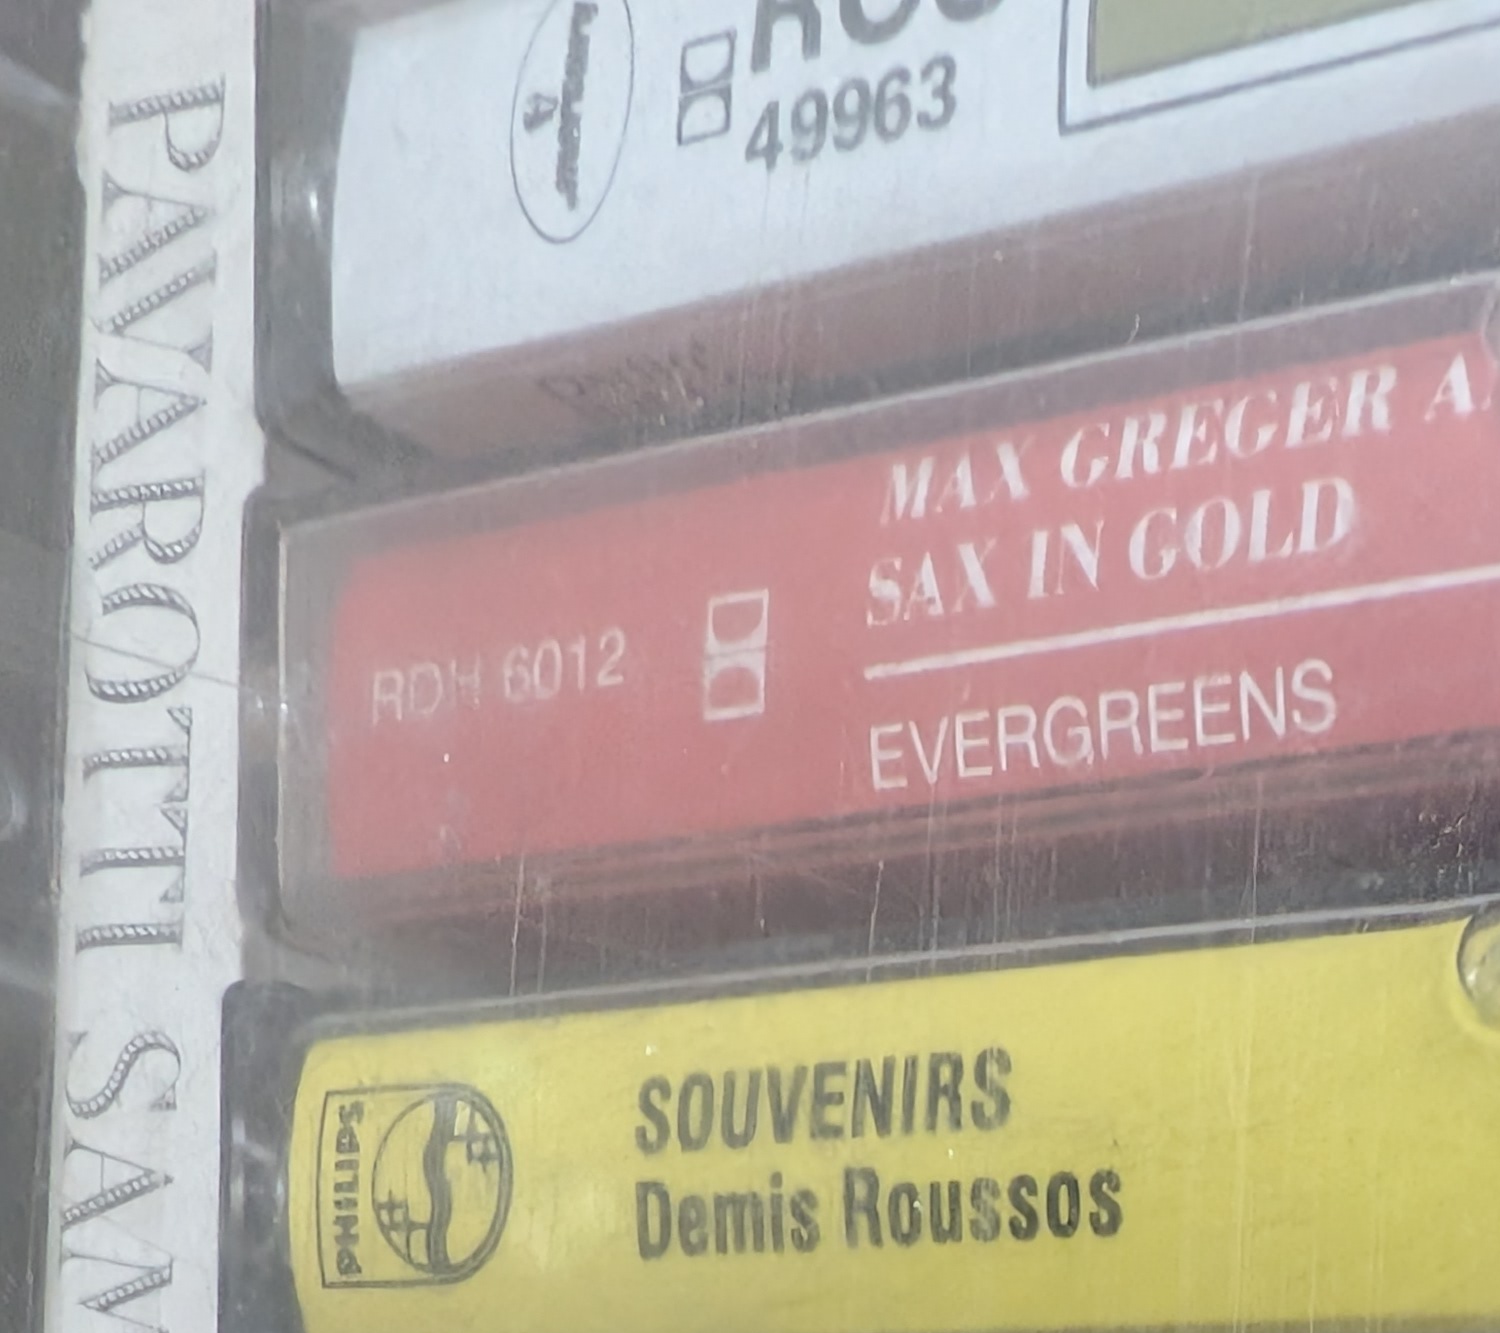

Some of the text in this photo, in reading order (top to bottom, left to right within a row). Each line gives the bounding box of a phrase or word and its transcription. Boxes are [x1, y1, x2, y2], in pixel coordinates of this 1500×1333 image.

[745, 54, 957, 173] 49963
[879, 442, 1031, 526] MAX
[1060, 364, 1398, 491] GREGER
[76, 74, 226, 953] PAVAROTTI
[865, 477, 1356, 627] SAX IN GOLD
[502, 626, 626, 703] 6012
[872, 659, 1338, 790] EVERGREENS
[635, 1046, 1013, 1156] SOUVENIRS
[333, 1101, 364, 1276] PHILIPS
[635, 1166, 1124, 1261] Demis Roussos
